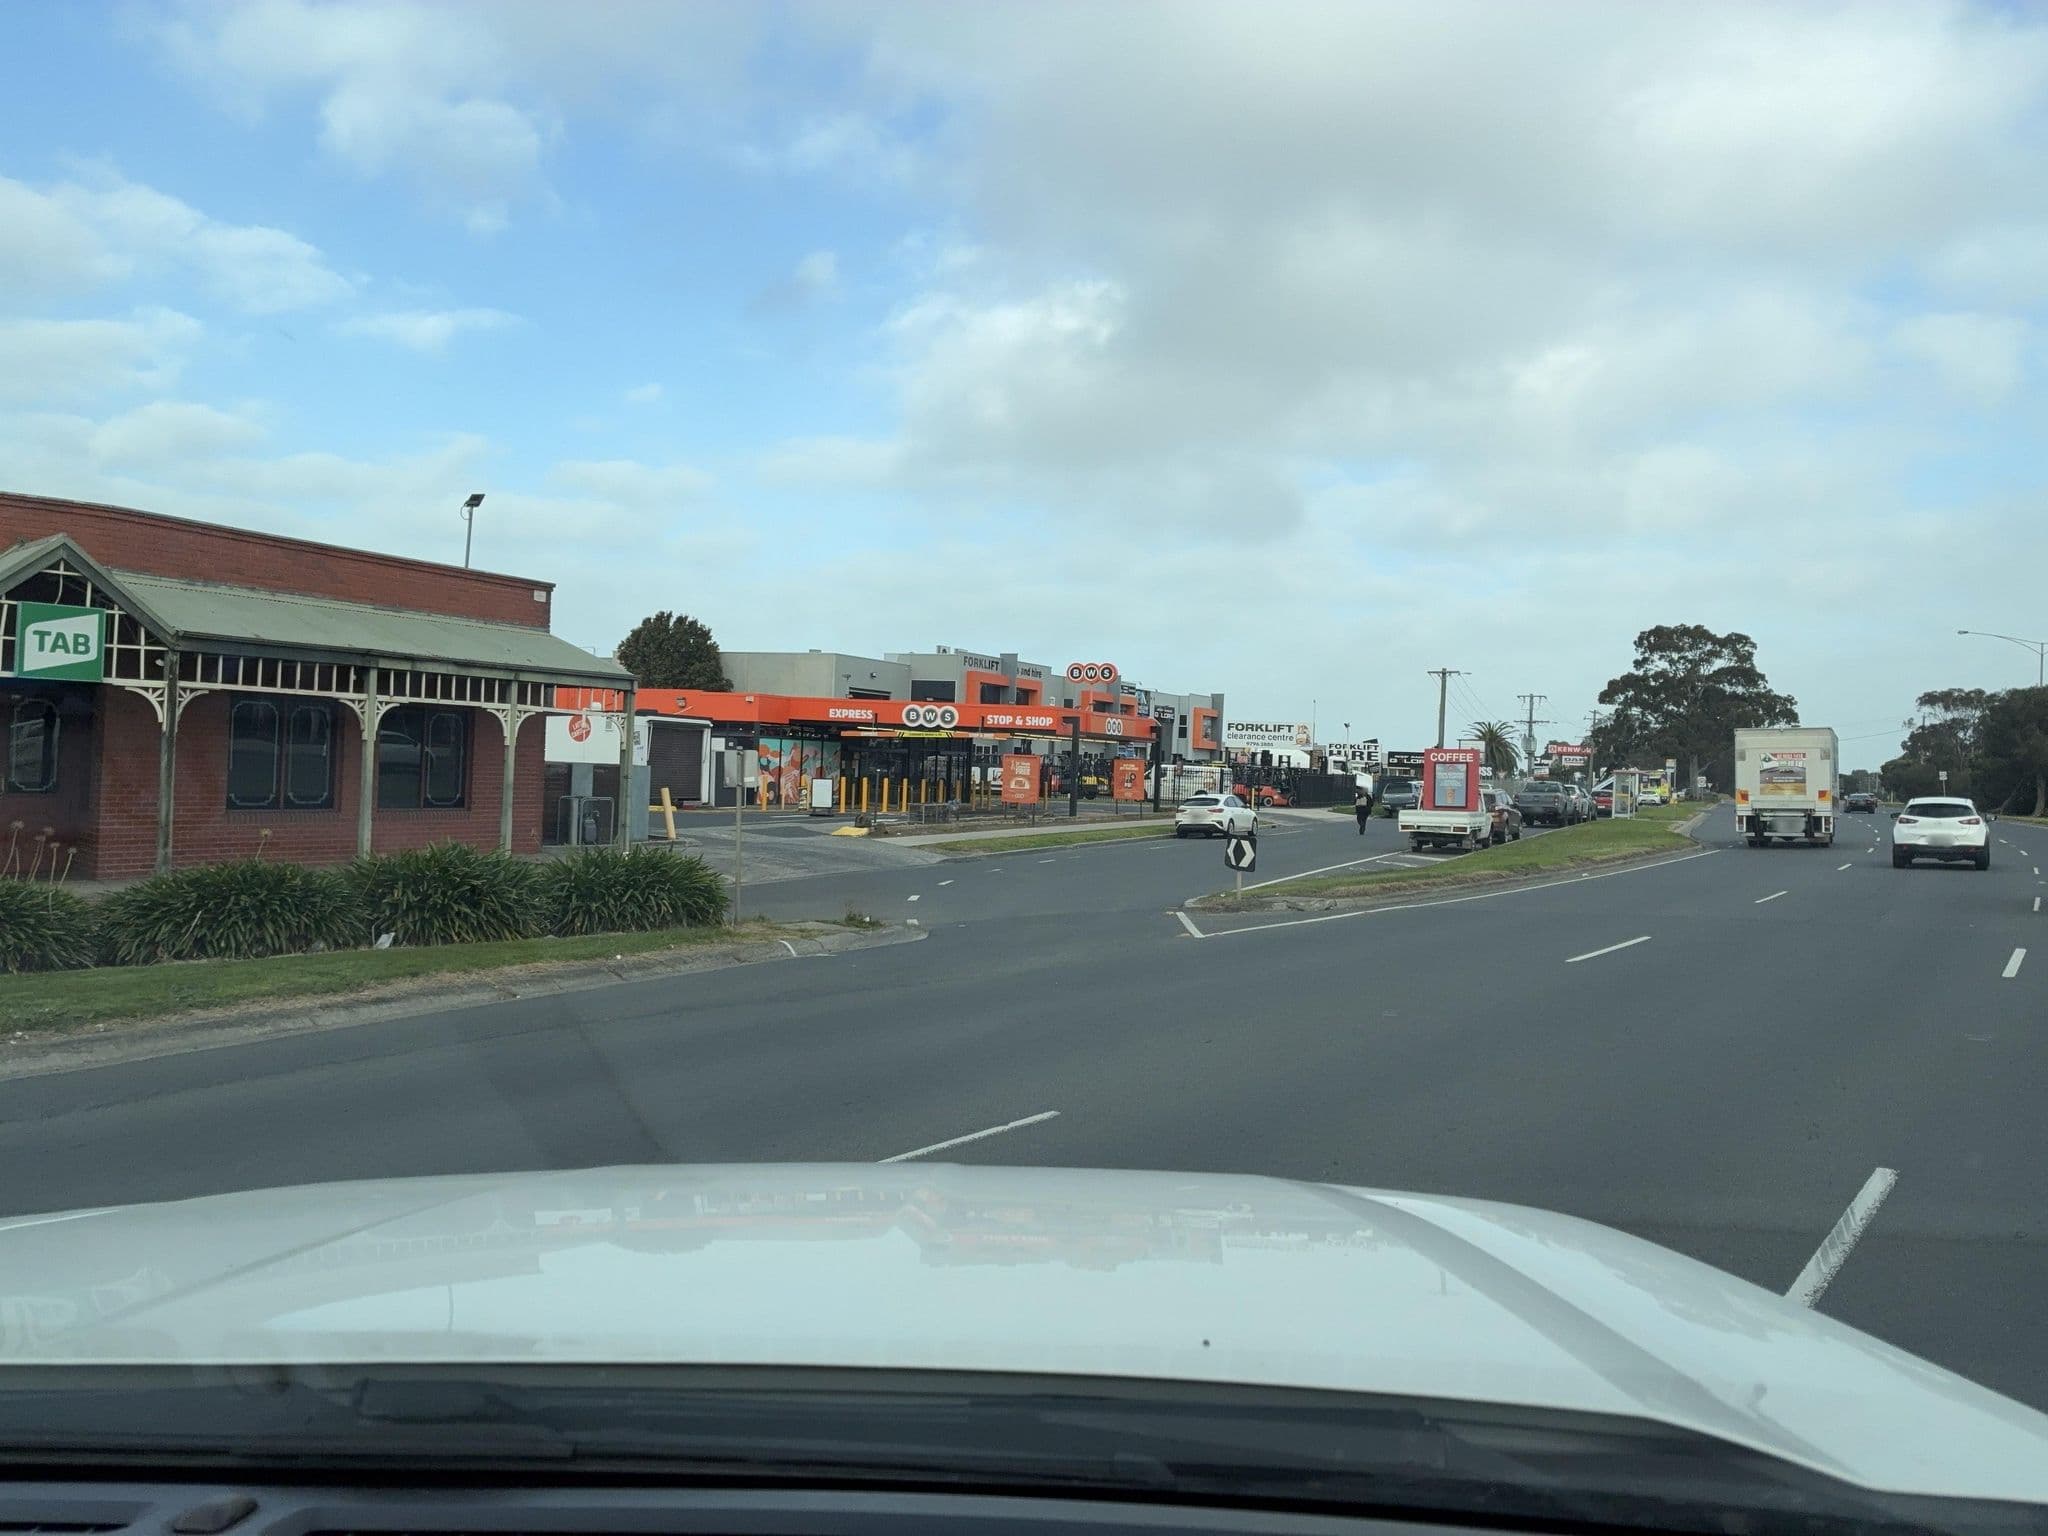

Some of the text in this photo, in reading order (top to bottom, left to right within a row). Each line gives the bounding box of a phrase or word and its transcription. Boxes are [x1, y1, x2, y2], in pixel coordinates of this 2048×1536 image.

[32, 630, 91, 655] TAB
[963, 656, 1000, 671] FORKLIFT
[829, 708, 873, 719] EXPRESS
[987, 715, 1053, 726] STOP & SHOP
[1227, 723, 1294, 733] FORKLIFT
[1227, 732, 1294, 742] clearance centre
[1430, 753, 1474, 762] COFFEE
